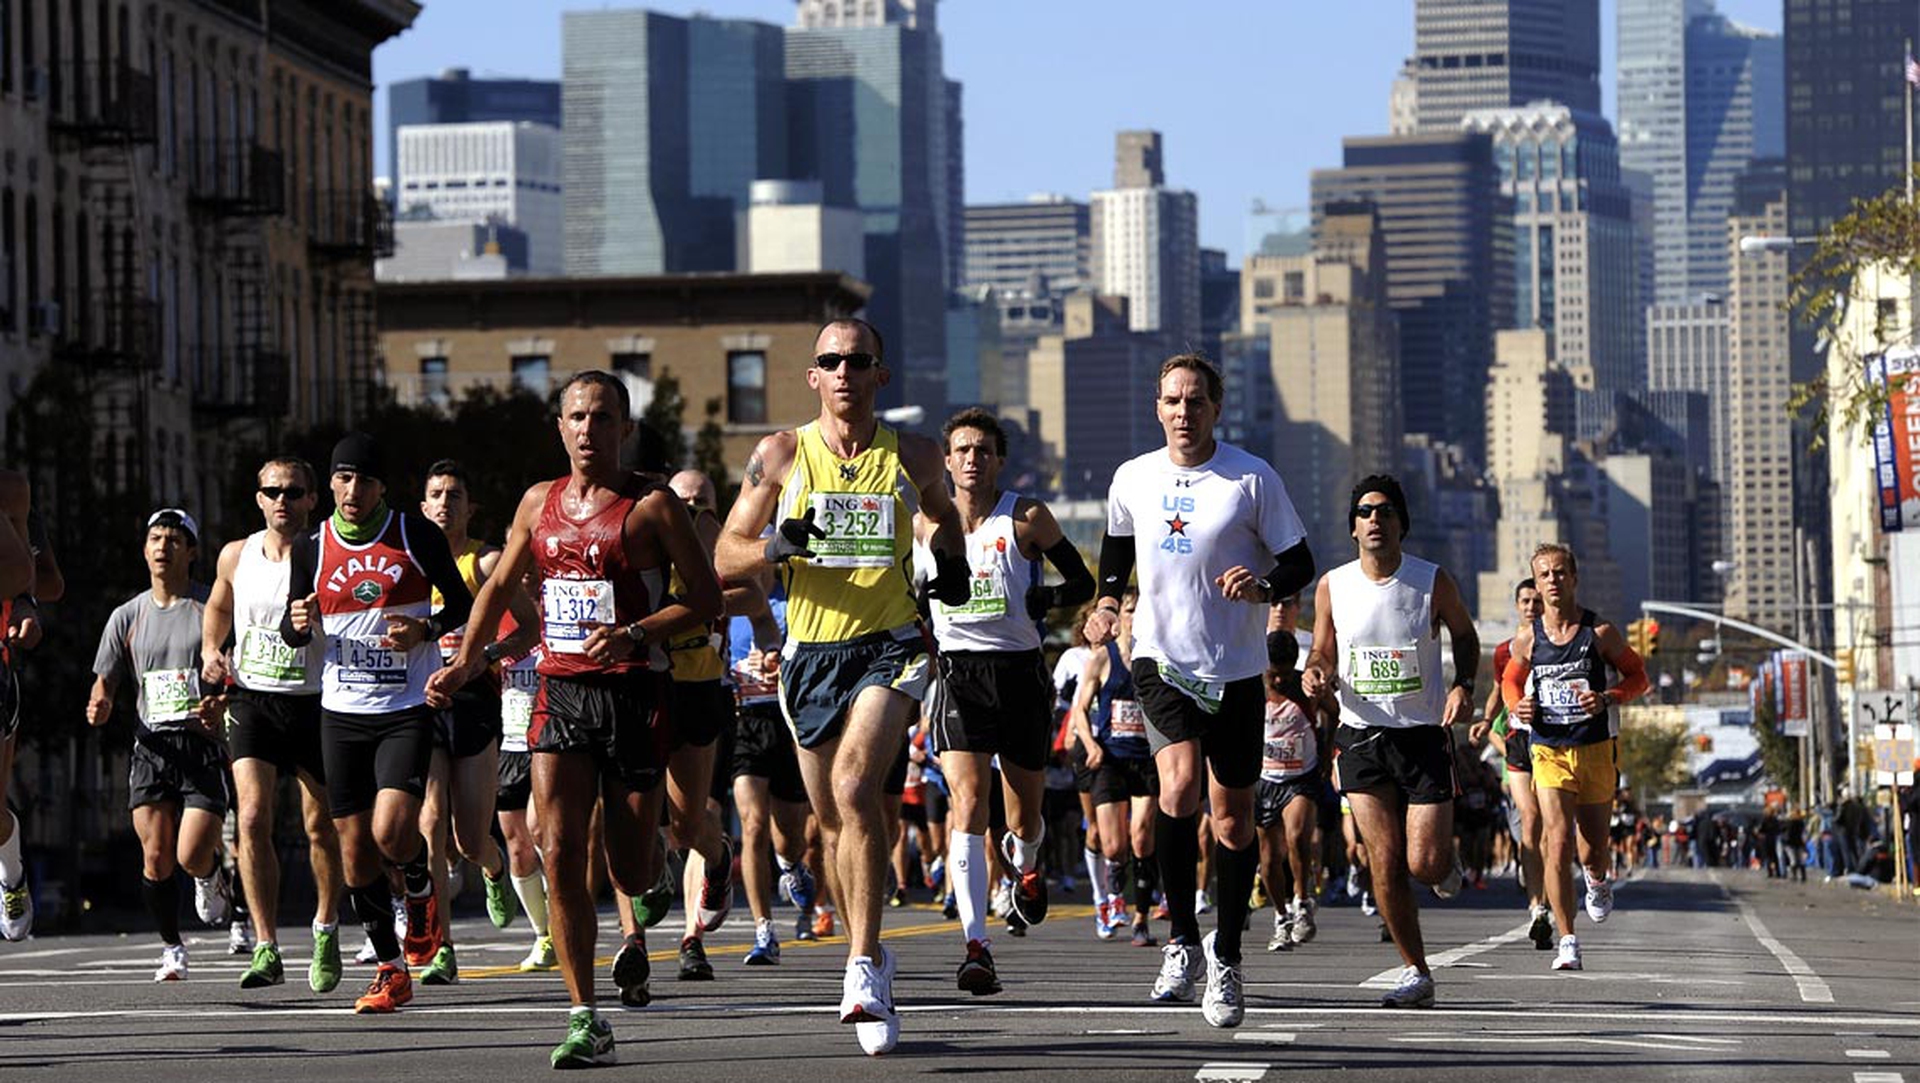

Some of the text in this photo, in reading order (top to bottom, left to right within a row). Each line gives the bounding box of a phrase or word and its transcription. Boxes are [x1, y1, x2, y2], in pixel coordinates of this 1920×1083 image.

[826, 499, 857, 511] ING
[1163, 495, 1195, 512] US
[824, 512, 879, 536] 3-252
[1160, 537, 1193, 554] 45
[326, 555, 404, 593] ITALIA
[553, 586, 580, 596] ING
[556, 598, 597, 621] 1-312
[349, 639, 377, 648] ING
[350, 649, 393, 668] 4-575
[1363, 651, 1388, 660] ING
[1370, 660, 1400, 679] 689
